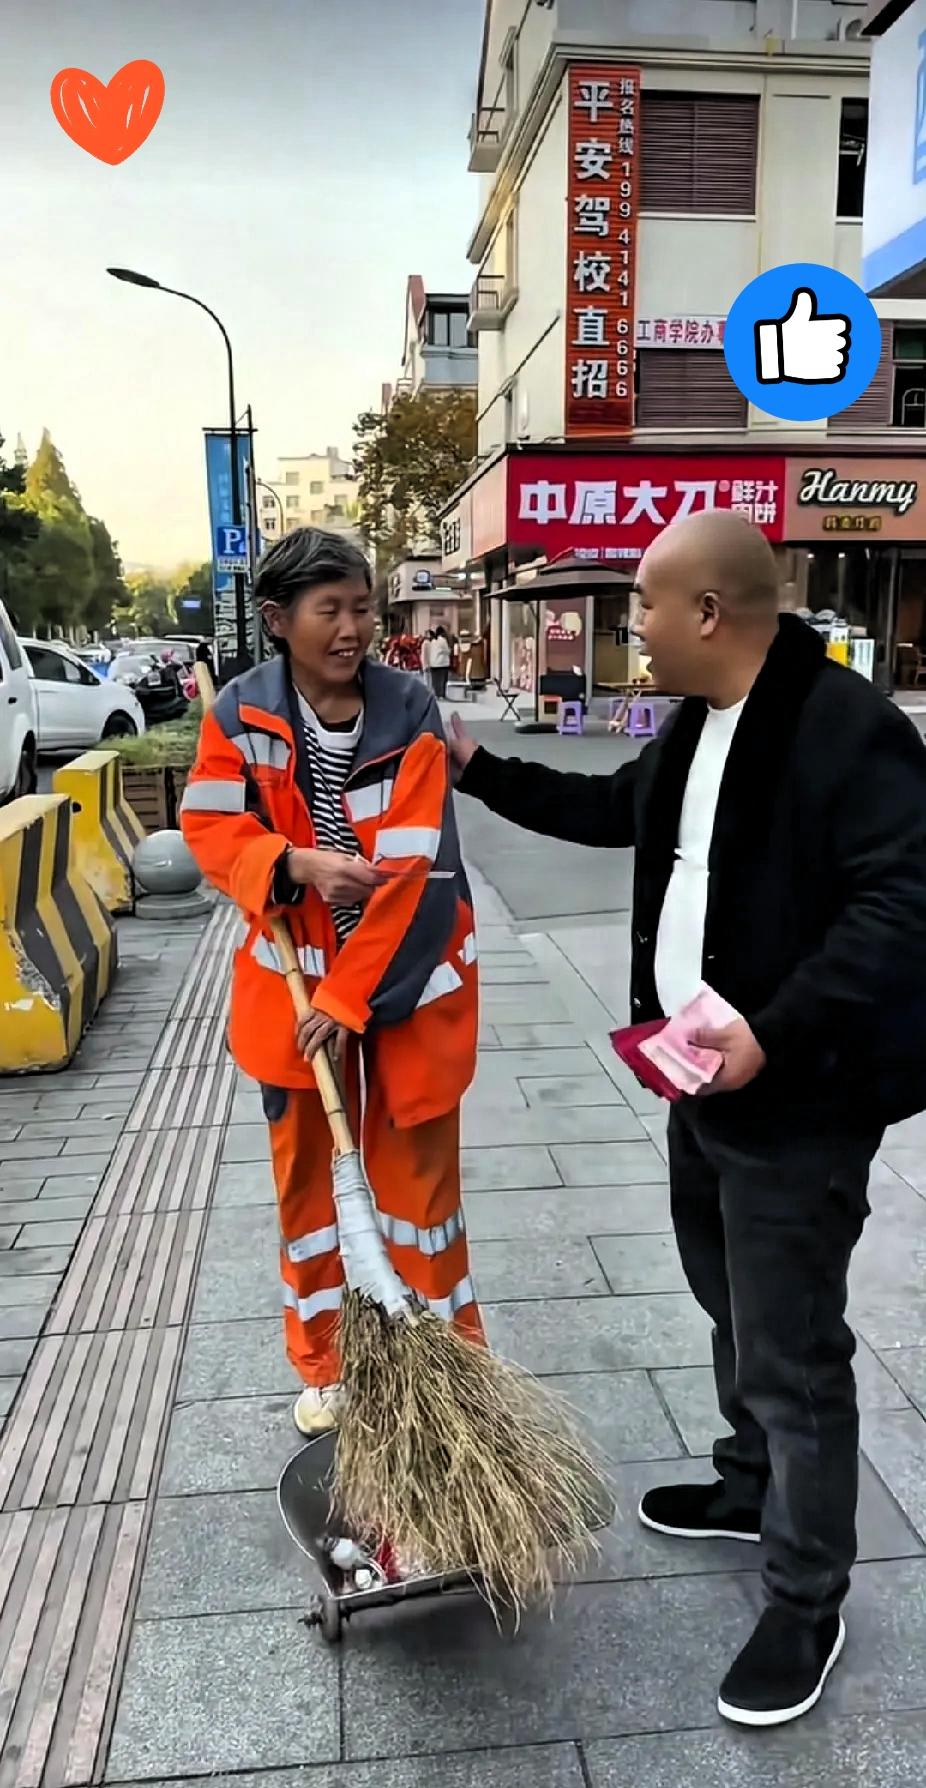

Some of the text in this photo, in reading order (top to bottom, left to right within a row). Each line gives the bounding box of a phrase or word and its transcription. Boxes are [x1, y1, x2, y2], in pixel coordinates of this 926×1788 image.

[572, 80, 614, 398] 平安驾校直招
[518, 479, 717, 525] 中原大刀
[731, 479, 779, 502] 鲜汁
[799, 469, 918, 513] Hanmy
[223, 528, 237, 555] P
